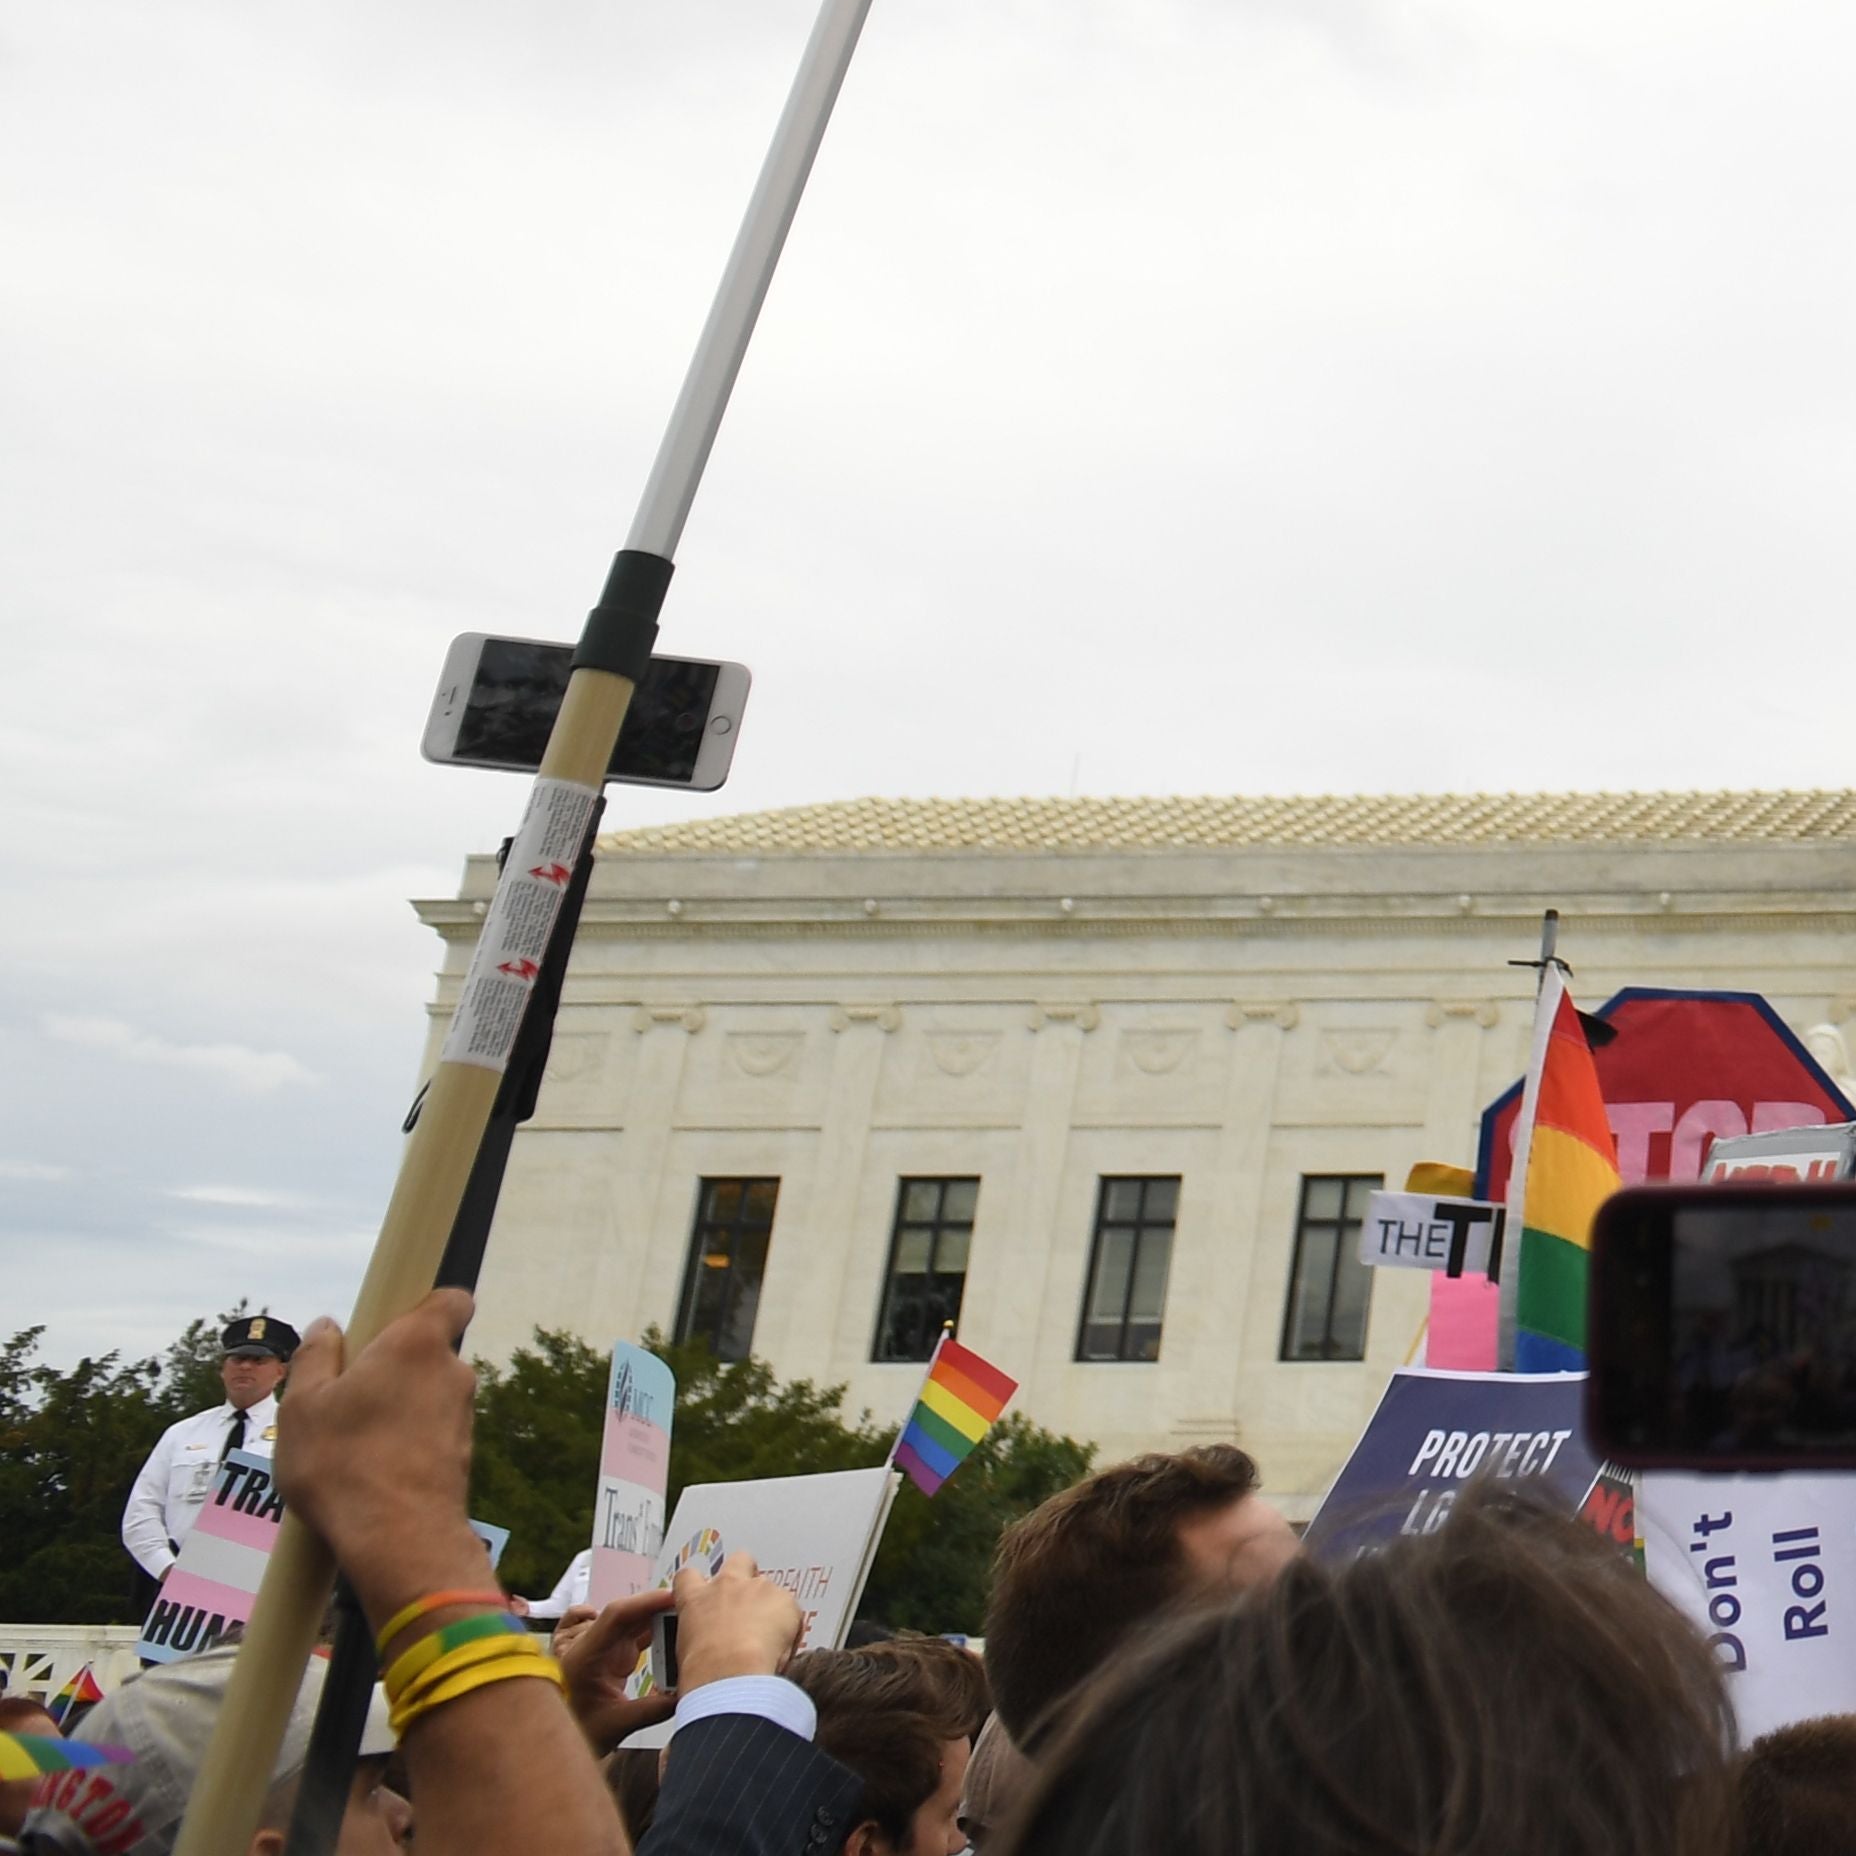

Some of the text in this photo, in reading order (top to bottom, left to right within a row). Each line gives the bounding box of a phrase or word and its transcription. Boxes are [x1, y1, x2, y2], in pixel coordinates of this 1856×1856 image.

[1377, 1218, 1449, 1259] THE
[1408, 1429, 1573, 1480] PROTECT
[215, 1461, 285, 1524] TRA
[1690, 1511, 1748, 1674] Don't
[1772, 1526, 1829, 1641] Roll
